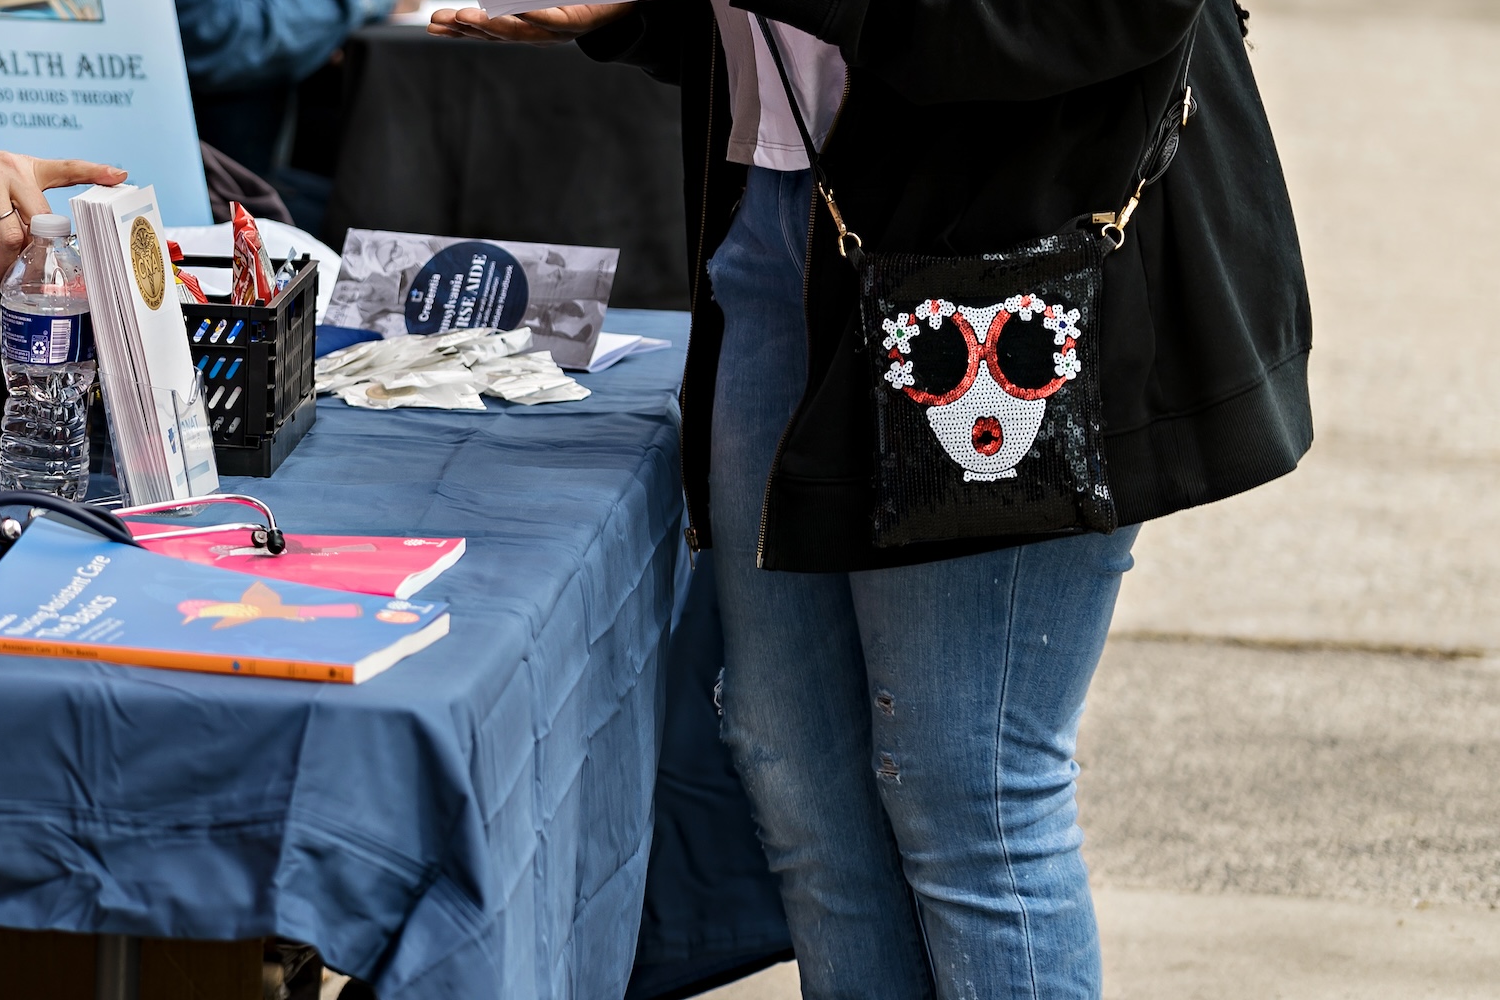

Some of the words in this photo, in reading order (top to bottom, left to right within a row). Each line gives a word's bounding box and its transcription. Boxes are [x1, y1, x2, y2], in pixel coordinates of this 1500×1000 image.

[76, 53, 147, 80] AIDE
[19, 88, 69, 104] HOURS
[72, 89, 135, 106] THEORY
[12, 112, 83, 129] CLINICAL
[465, 253, 488, 296] AIDE
[418, 273, 441, 322] Credentia
[439, 273, 464, 334] nnsylvania
[455, 296, 477, 328] RSE
[76, 554, 112, 578] Care
[60, 594, 118, 625] Basics
